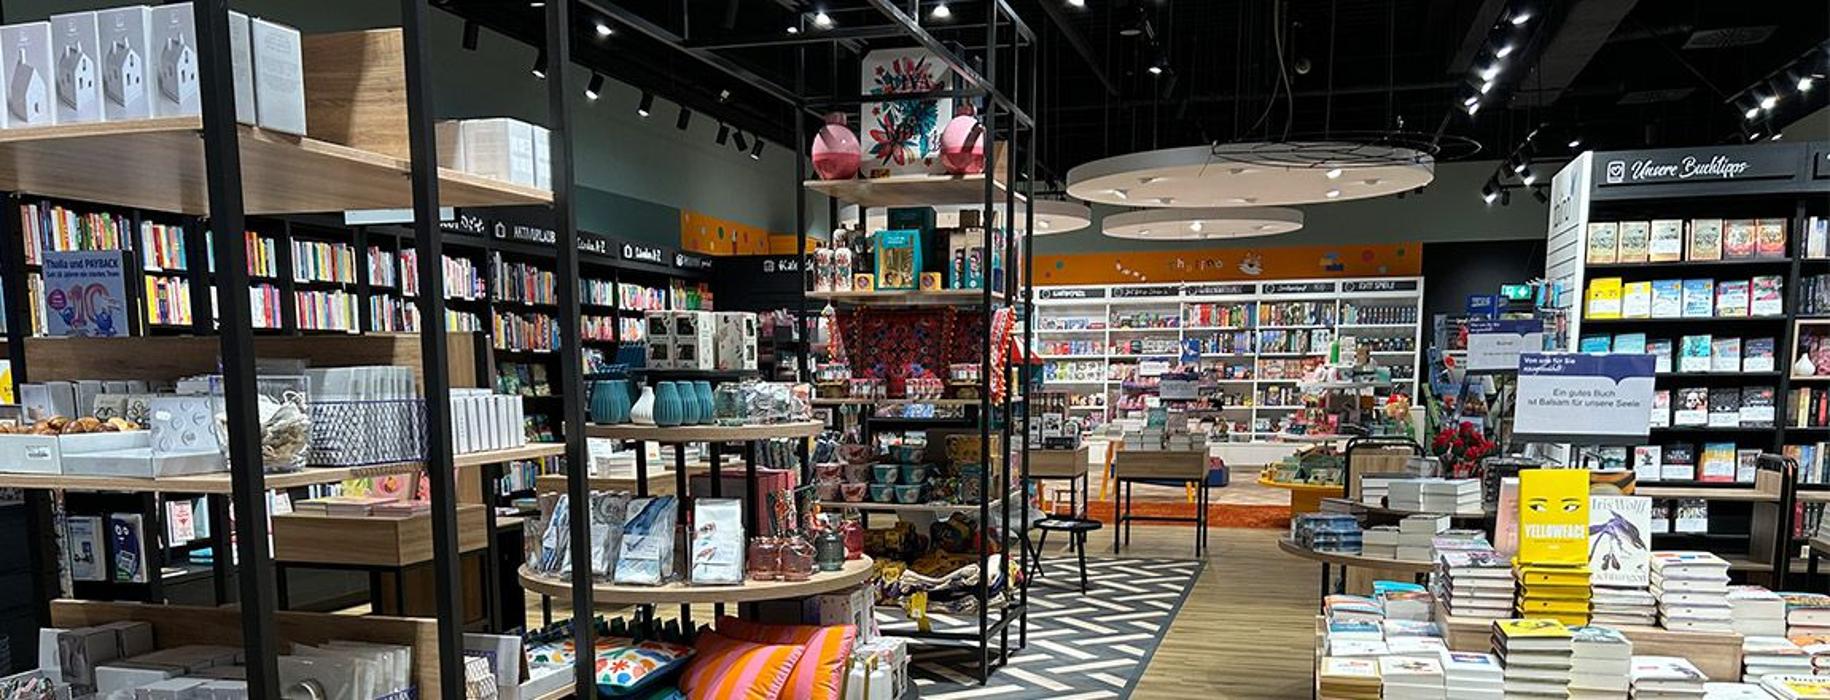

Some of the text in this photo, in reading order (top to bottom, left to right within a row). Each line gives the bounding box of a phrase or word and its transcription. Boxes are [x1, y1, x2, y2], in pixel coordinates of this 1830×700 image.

[1631, 156, 1750, 180] Unsere Buchtipps
[84, 258, 119, 268] PAYBACK
[1553, 389, 1616, 399] Ein gutes Buch
[1538, 398, 1570, 406] Balsam
[1571, 398, 1583, 407] für
[1584, 400, 1614, 408] unsere
[1616, 399, 1641, 408] Seele
[1592, 498, 1613, 510] Iris
[1614, 498, 1647, 513] Wolff
[1525, 524, 1585, 538] YELLOWFACE
